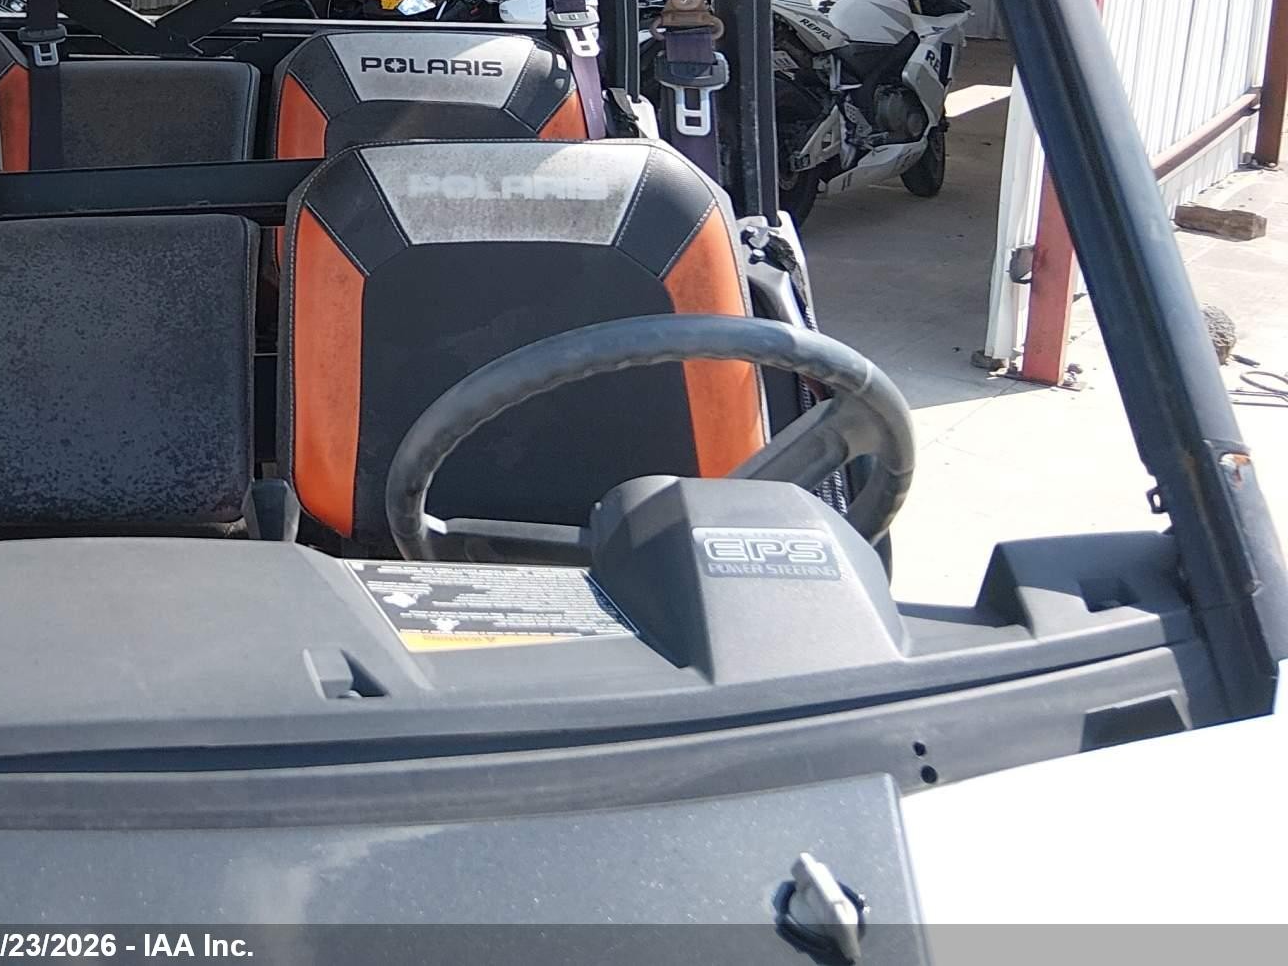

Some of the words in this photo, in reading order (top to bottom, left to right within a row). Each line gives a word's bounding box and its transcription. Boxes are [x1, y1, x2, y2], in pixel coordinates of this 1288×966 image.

[800, 18, 832, 40] REPSOL
[361, 56, 503, 77] POLARIS
[704, 538, 827, 563] EPS
[707, 562, 762, 575] POWER
[766, 564, 838, 577] STEERING
